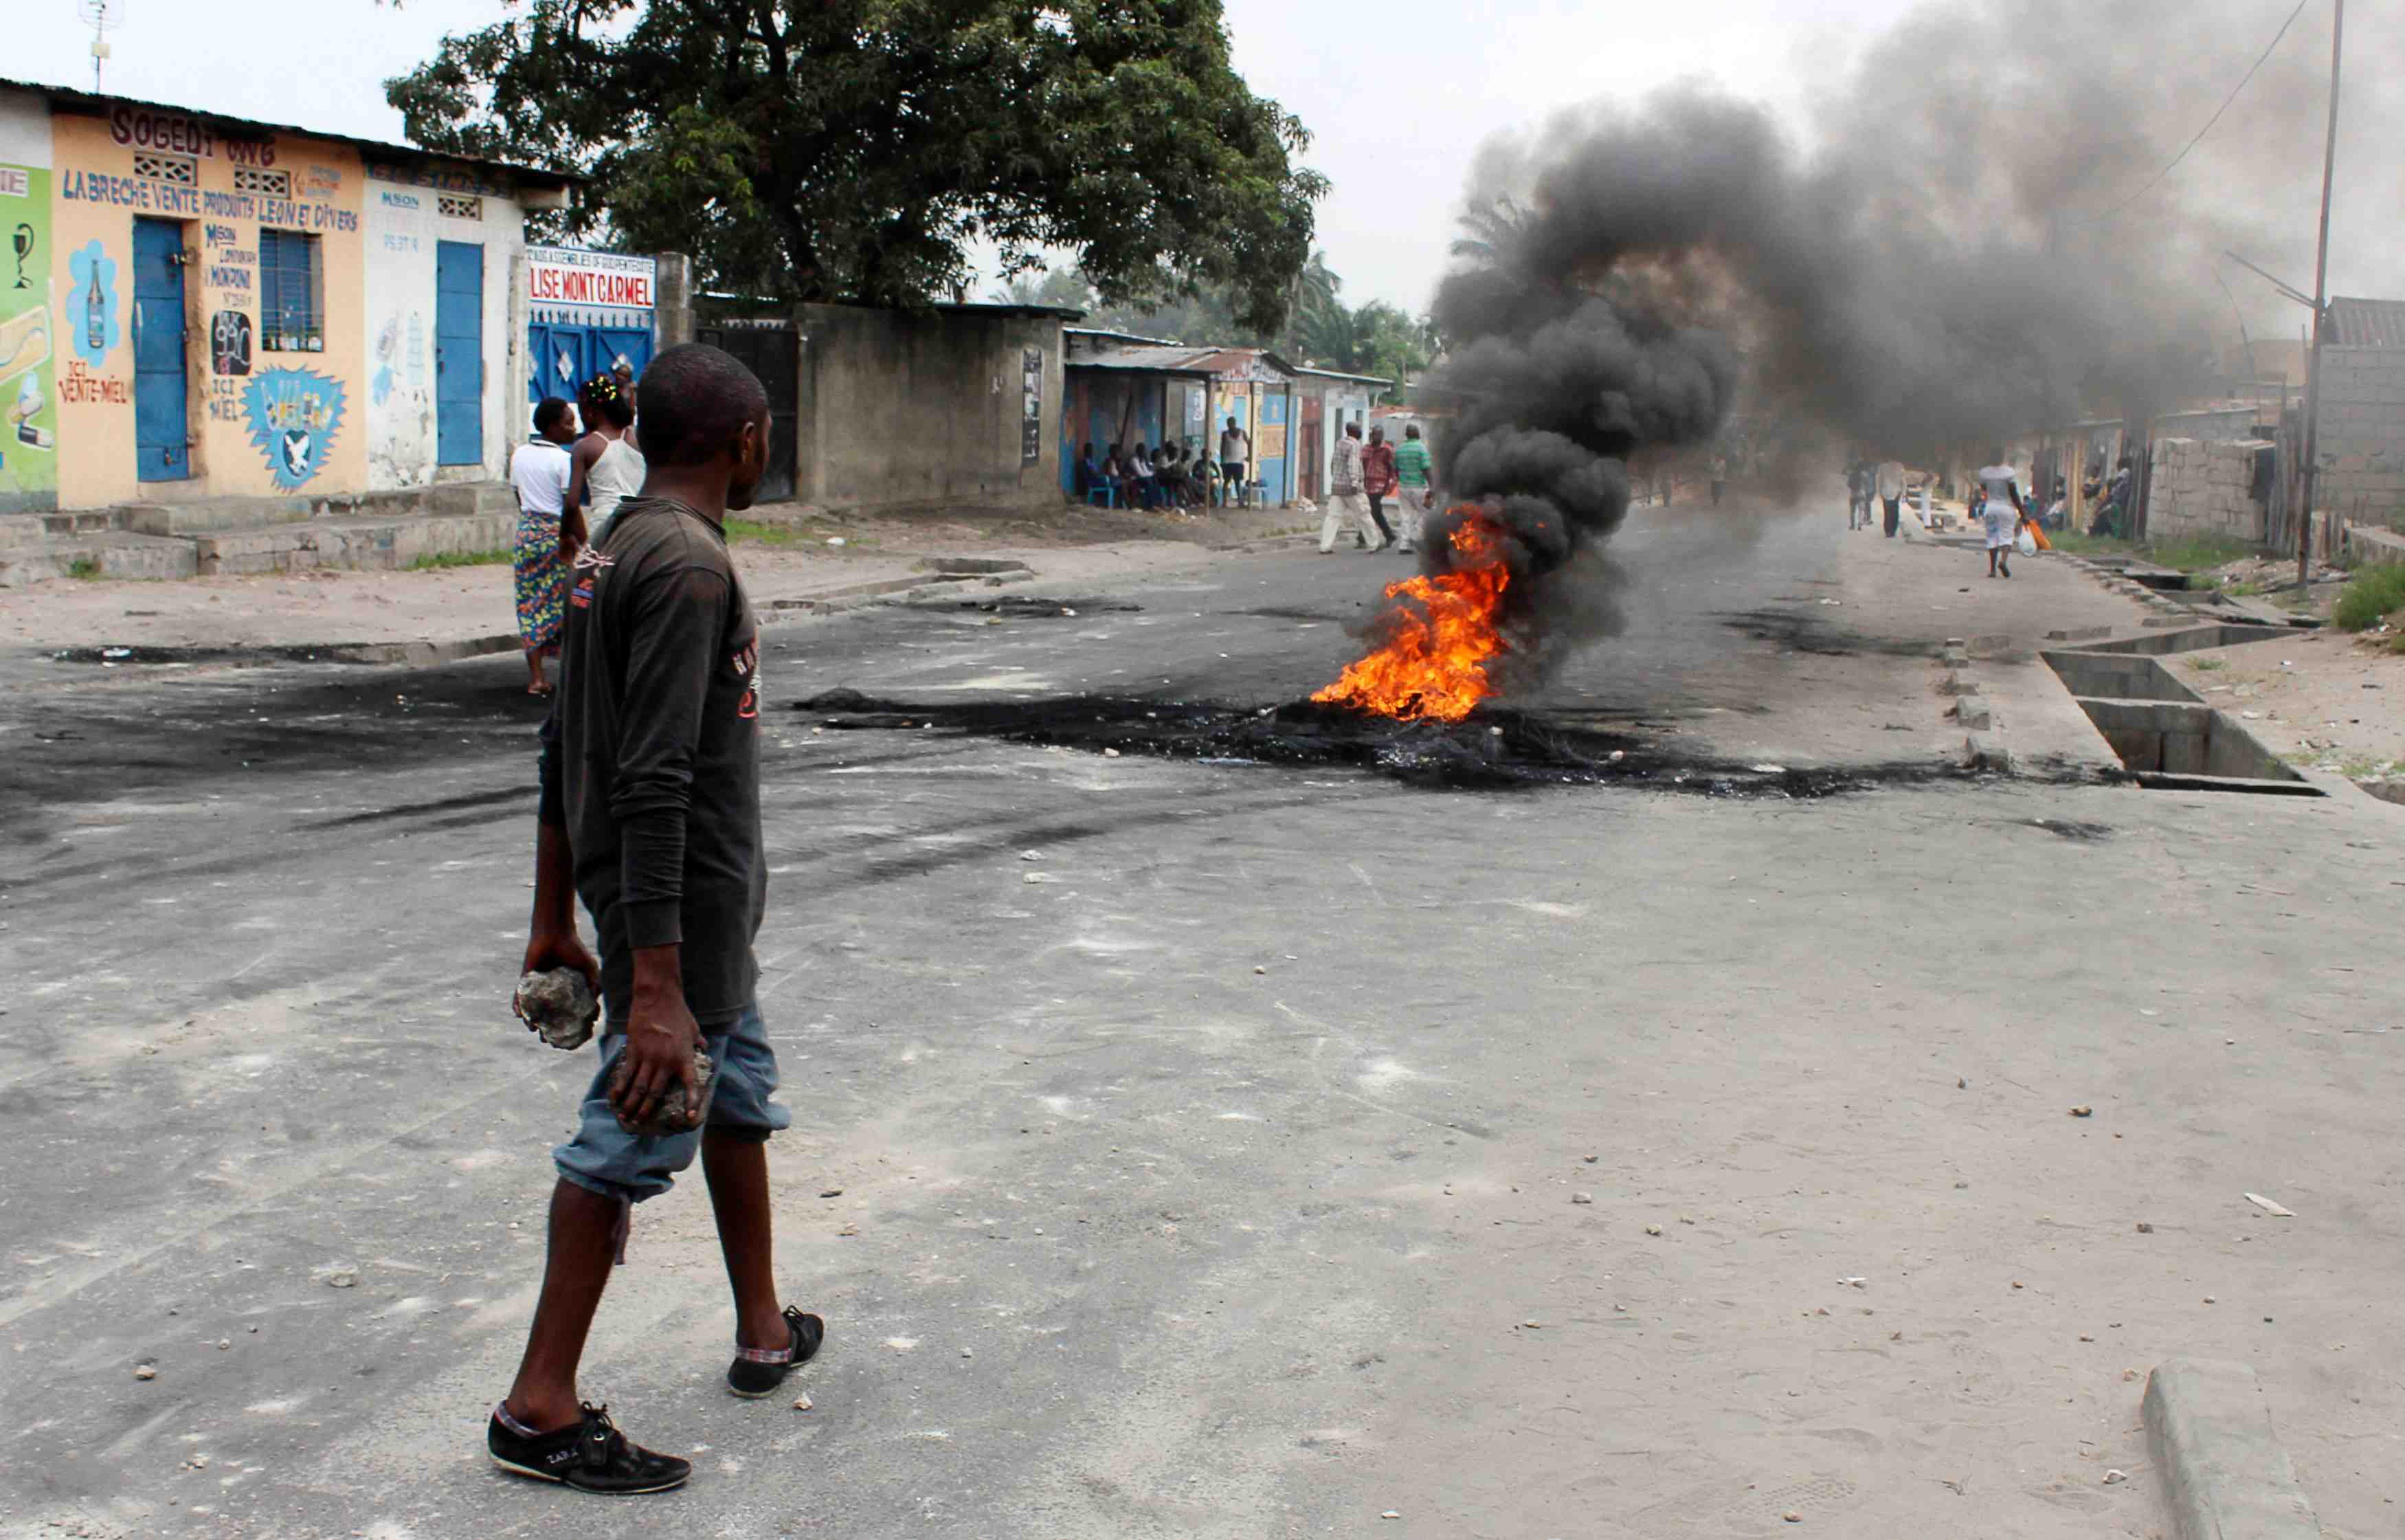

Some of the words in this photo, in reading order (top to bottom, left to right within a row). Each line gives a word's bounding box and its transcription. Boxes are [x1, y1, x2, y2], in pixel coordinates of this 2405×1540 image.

[152, 182, 199, 213] VENTE
[203, 191, 254, 219] PRODUITS
[562, 269, 595, 302] MONT
[598, 274, 653, 306] CARMEL
[212, 378, 235, 396] ICI
